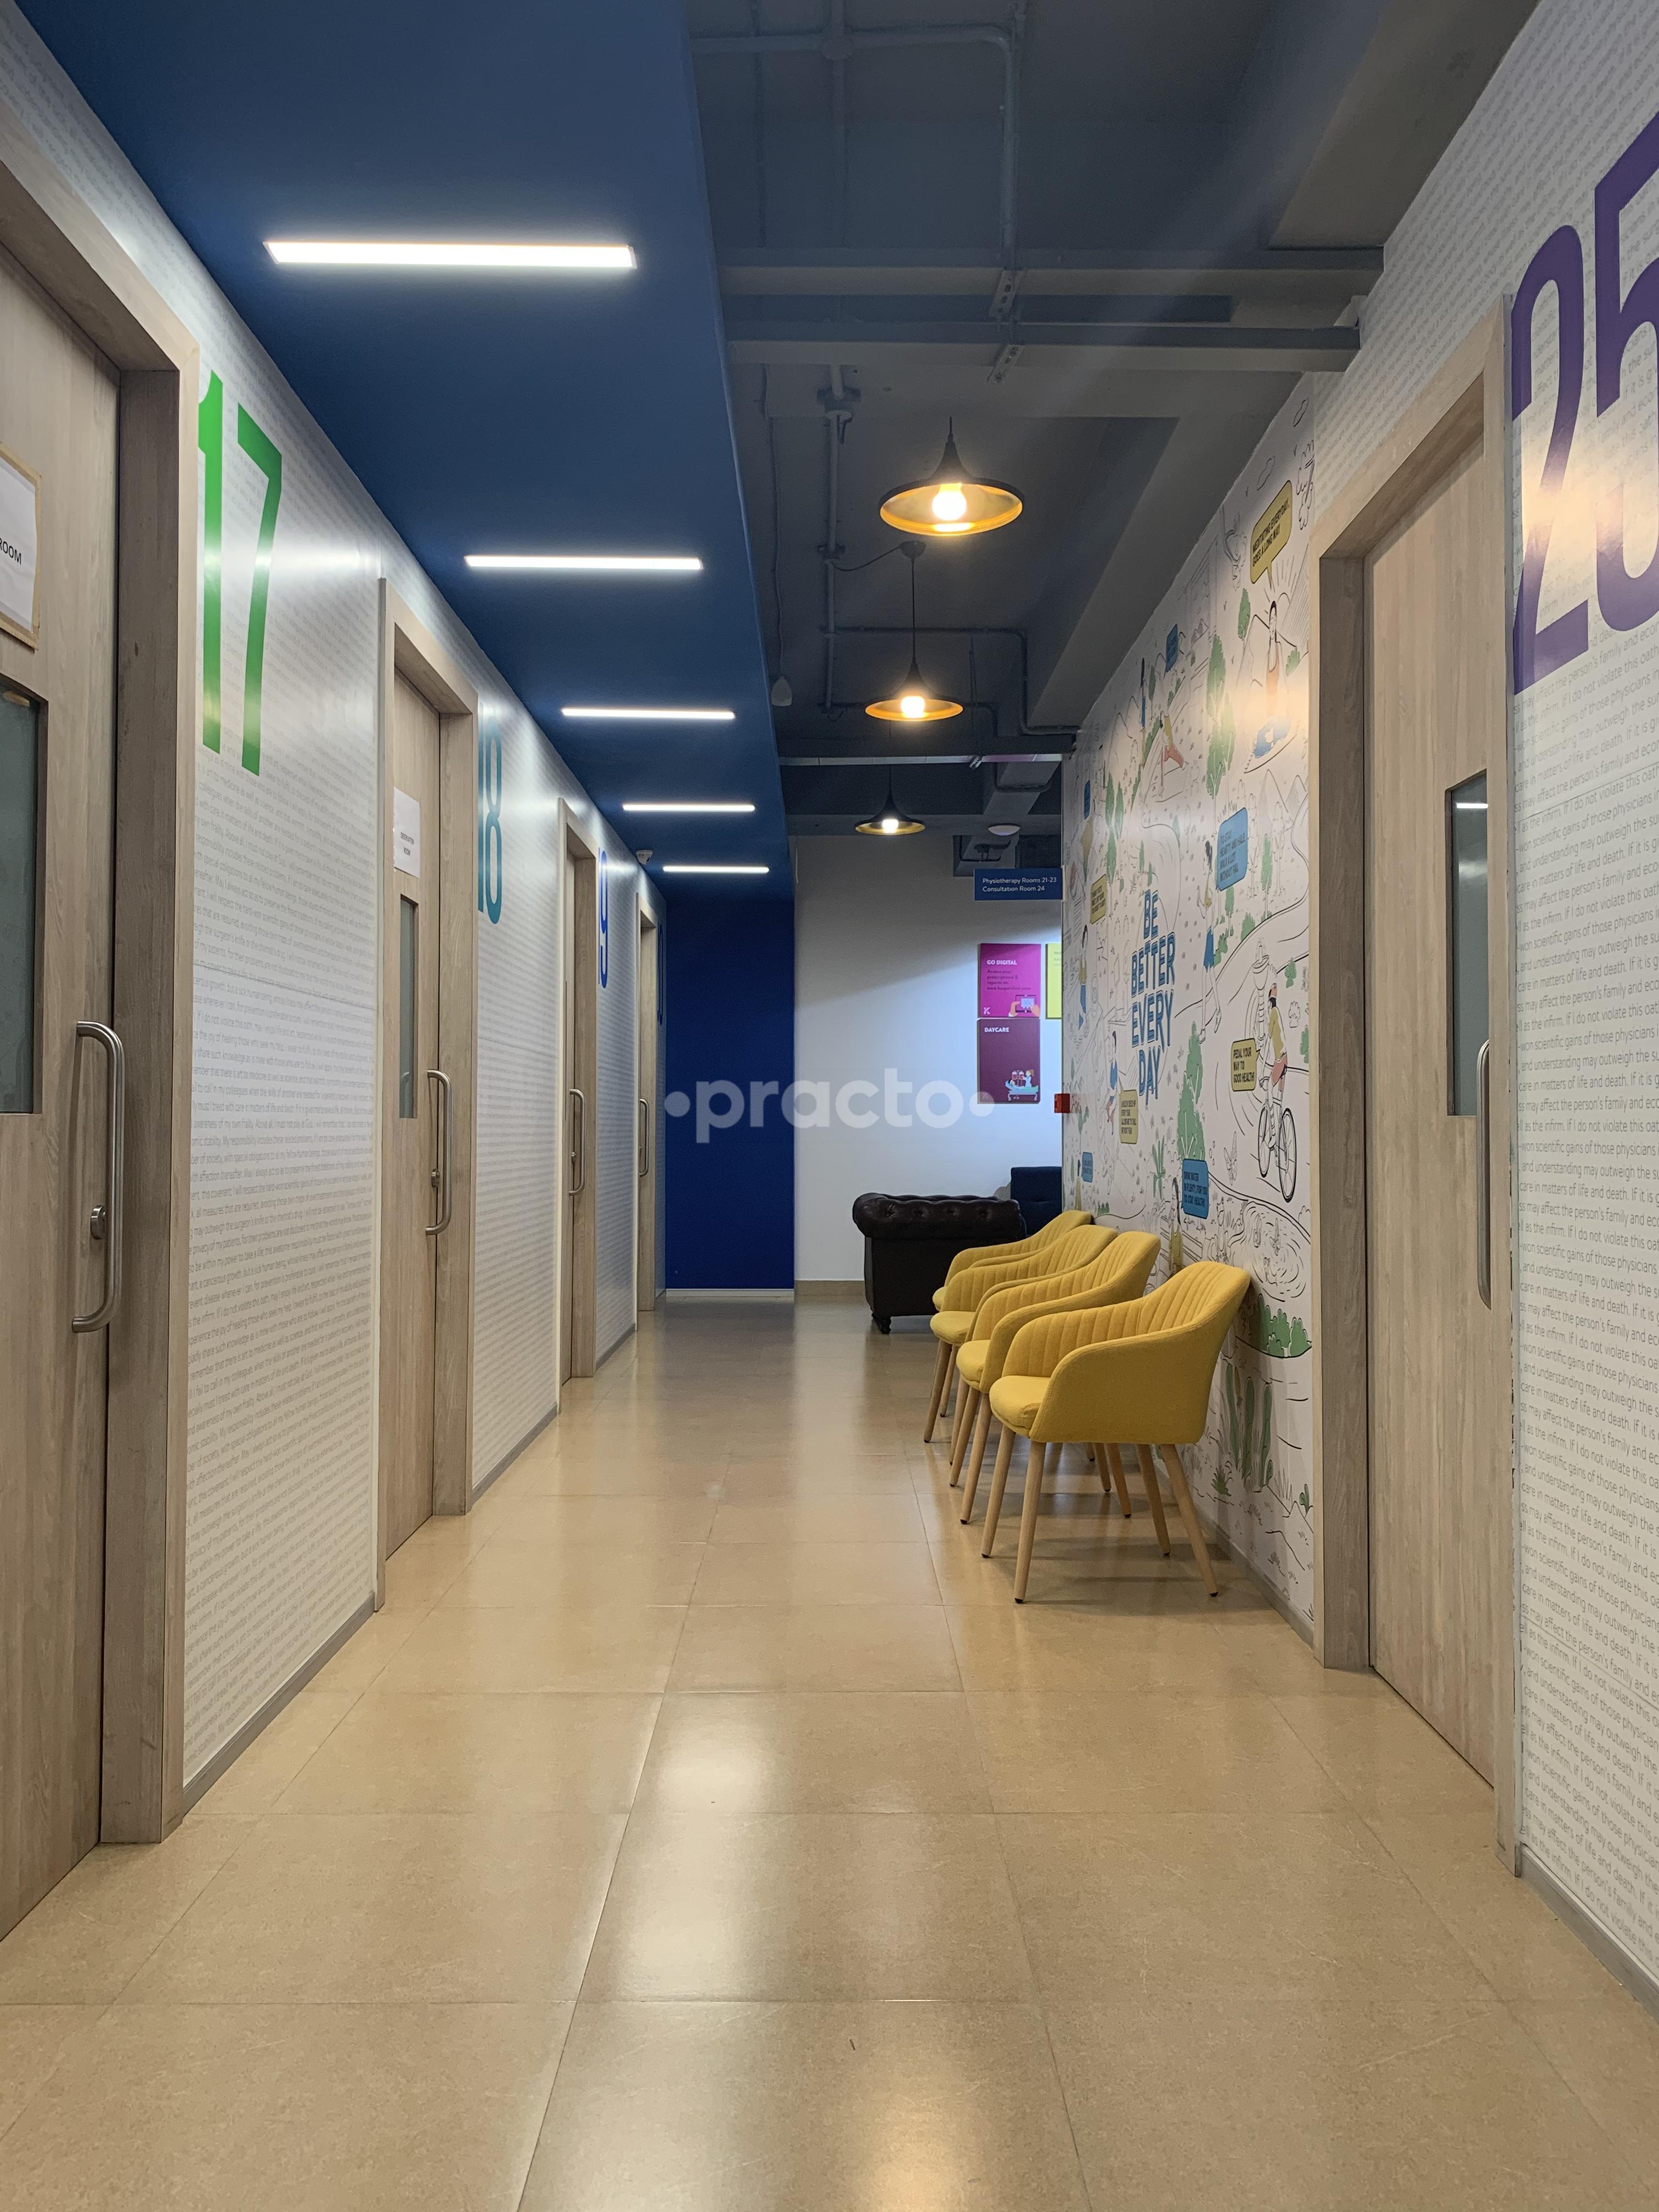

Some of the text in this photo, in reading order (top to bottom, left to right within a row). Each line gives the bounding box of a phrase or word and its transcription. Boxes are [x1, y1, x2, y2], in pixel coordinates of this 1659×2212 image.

[198, 369, 282, 776] 17
[1522, 630, 1637, 710] may affect the person's family and
[1517, 837, 1649, 893] care in matters of life and death. If it is
[1143, 889, 1159, 940] BE
[1131, 932, 1176, 998] BETTER
[1131, 989, 1174, 1053] EVERY
[1138, 1046, 1161, 1105] DAY
[1233, 1047, 1251, 1059] PEDAL YOUR
[1240, 1060, 1245, 1070] TO
[1522, 1047, 1649, 1071] and understanding may outweigh the
[1536, 1138, 1656, 1160] scientific gains of those physicians
[1528, 1302, 1645, 1344] may affect the person's family and
[1527, 1424, 1533, 1436] as
[1535, 1424, 1545, 1441] the
[1548, 1429, 1568, 1451] infirm.
[1570, 1438, 1574, 1453] If
[1580, 1443, 1589, 1460] do
[1592, 1451, 1603, 1466] not
[1605, 1455, 1630, 1477] violate
[1632, 1464, 1646, 1485] this
[1522, 1582, 1657, 1679] care in matters of life and death. If it is
[1527, 1667, 1657, 1775] and understanding may outweigh the
[1542, 1760, 1622, 1839] scientific gains of those
